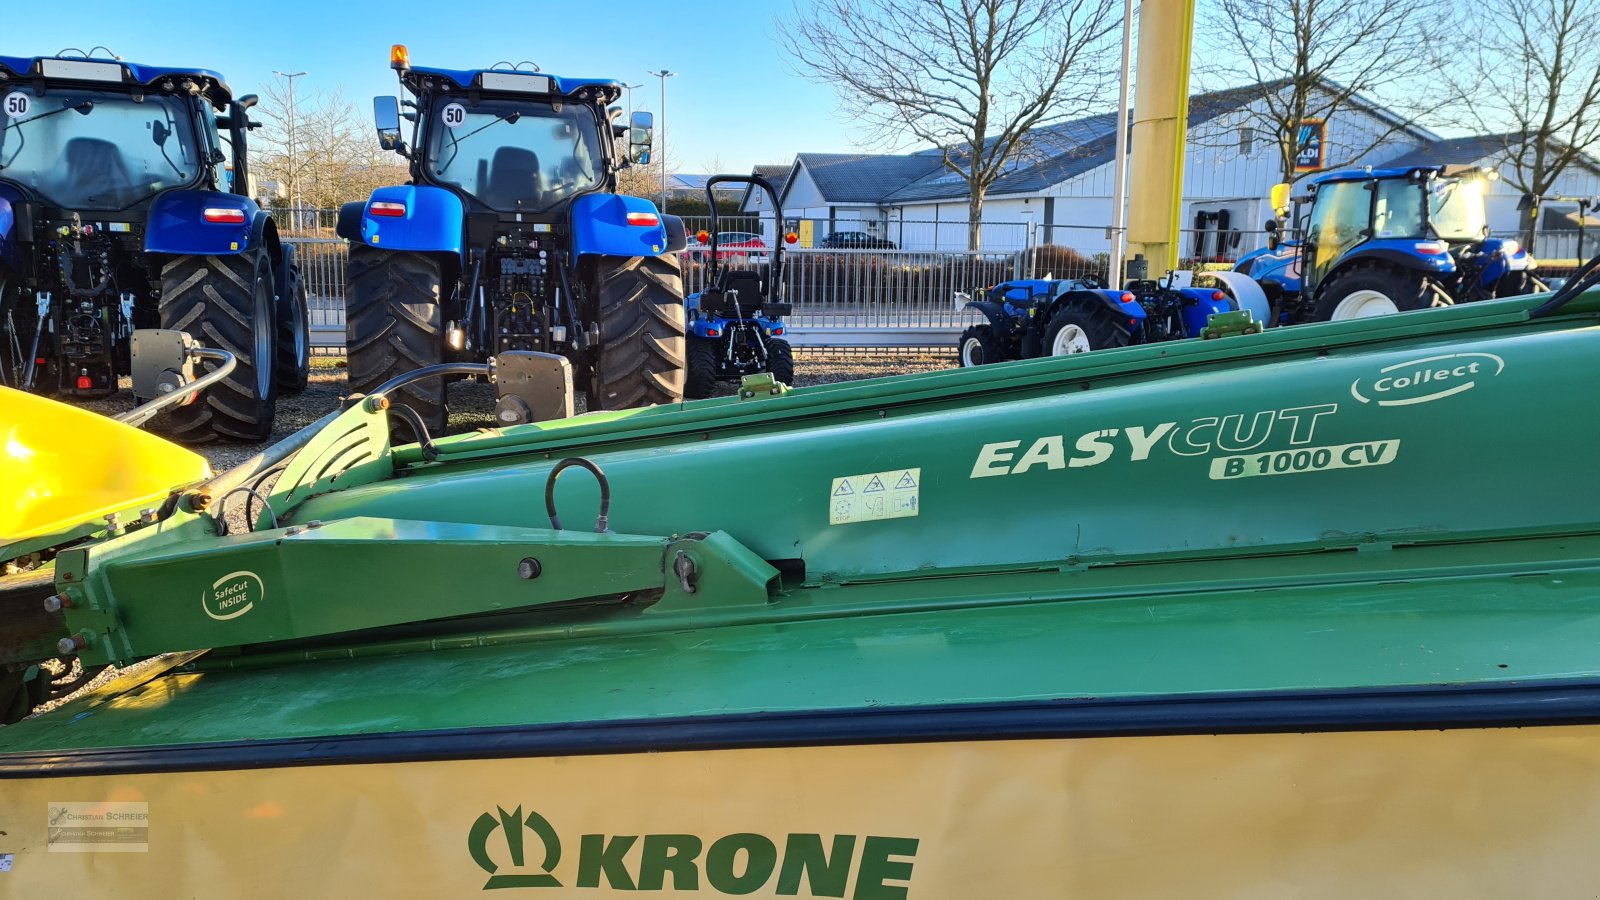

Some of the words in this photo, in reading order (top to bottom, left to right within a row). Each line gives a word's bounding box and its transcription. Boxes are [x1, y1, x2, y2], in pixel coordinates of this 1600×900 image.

[9, 97, 27, 113] 50
[446, 107, 463, 123] 50
[1373, 361, 1480, 392] Collect
[1224, 457, 1246, 477] B
[1257, 448, 1332, 474] 1000
[1341, 443, 1390, 465] CV
[215, 580, 248, 600] SafeCut
[219, 592, 247, 610] INSIDE
[576, 832, 920, 900] KRONE
